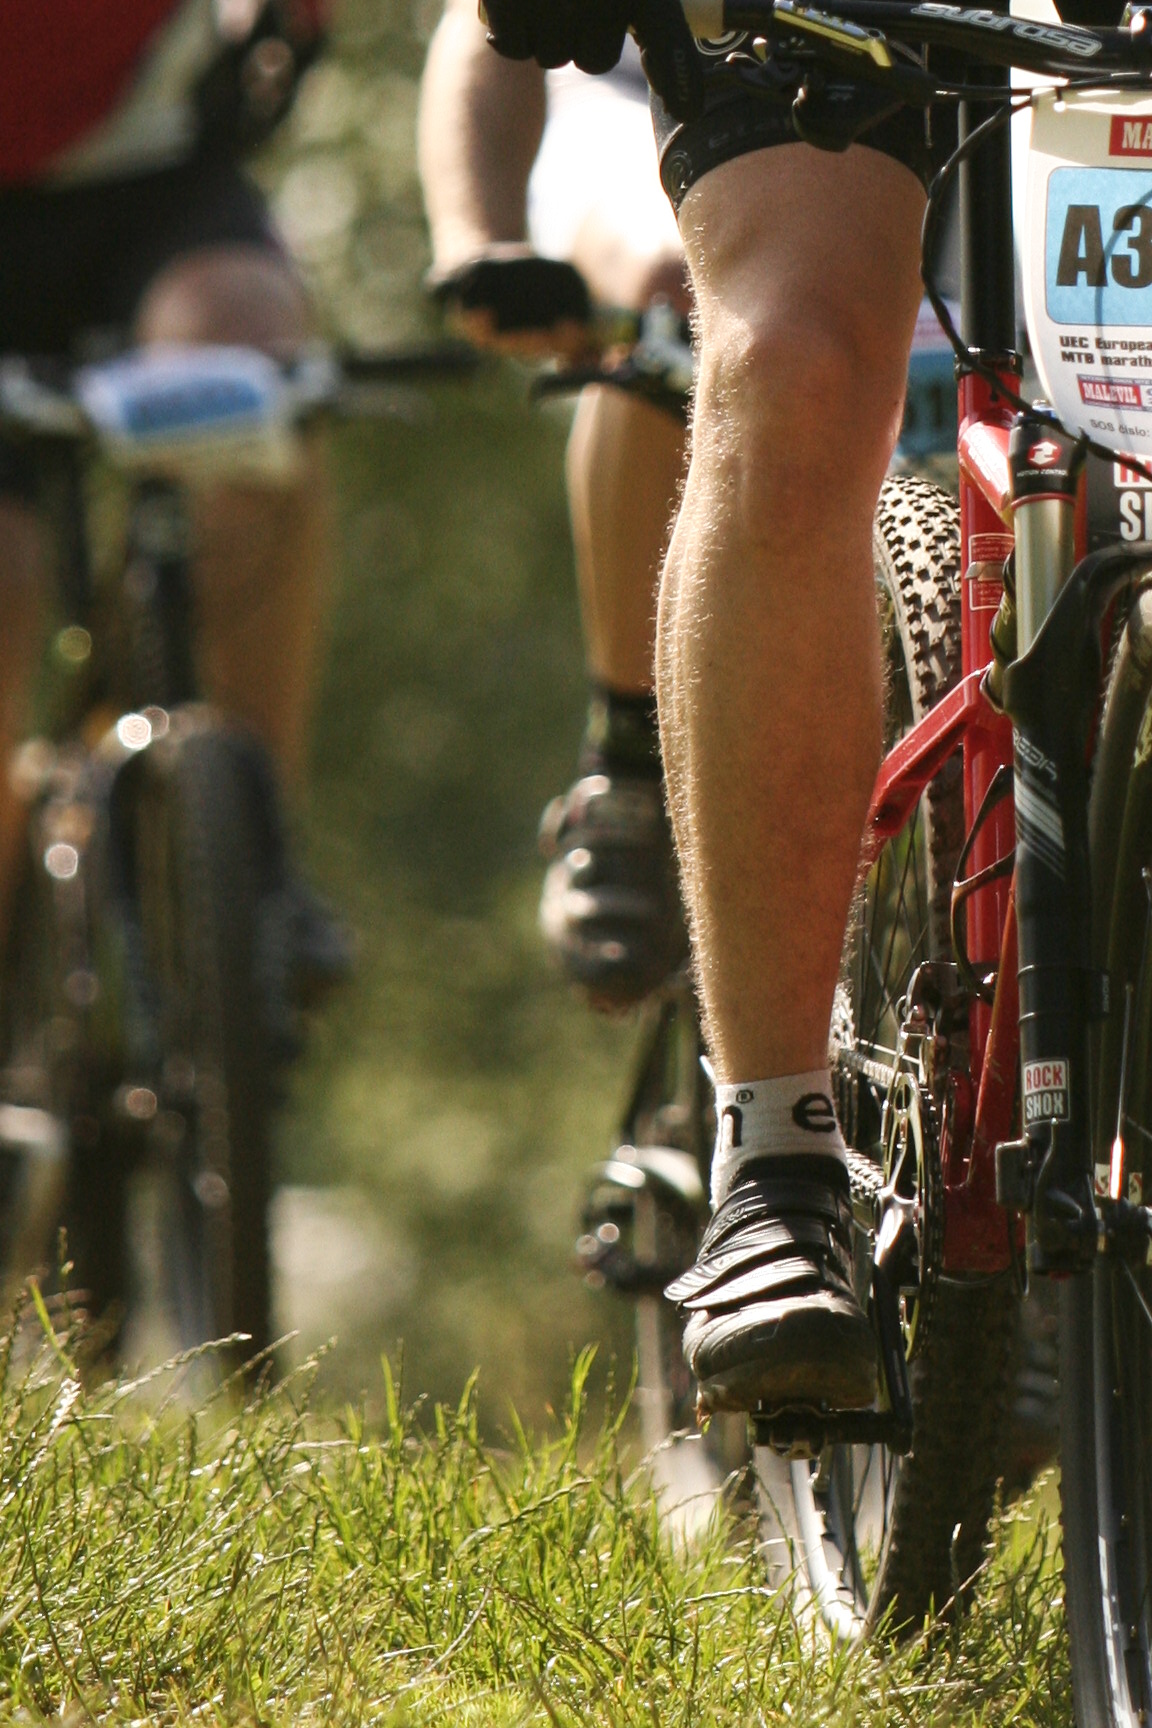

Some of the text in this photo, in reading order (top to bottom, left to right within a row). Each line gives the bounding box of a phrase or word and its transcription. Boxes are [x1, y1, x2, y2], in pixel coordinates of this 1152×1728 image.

[1059, 335, 1089, 349] UEC
[1061, 351, 1095, 365] MTB
[1082, 382, 1138, 404] MALEVIL
[1089, 419, 1116, 432] SOS
[1025, 1064, 1063, 1092] ROCK
[1026, 1092, 1064, 1120] SHOX
